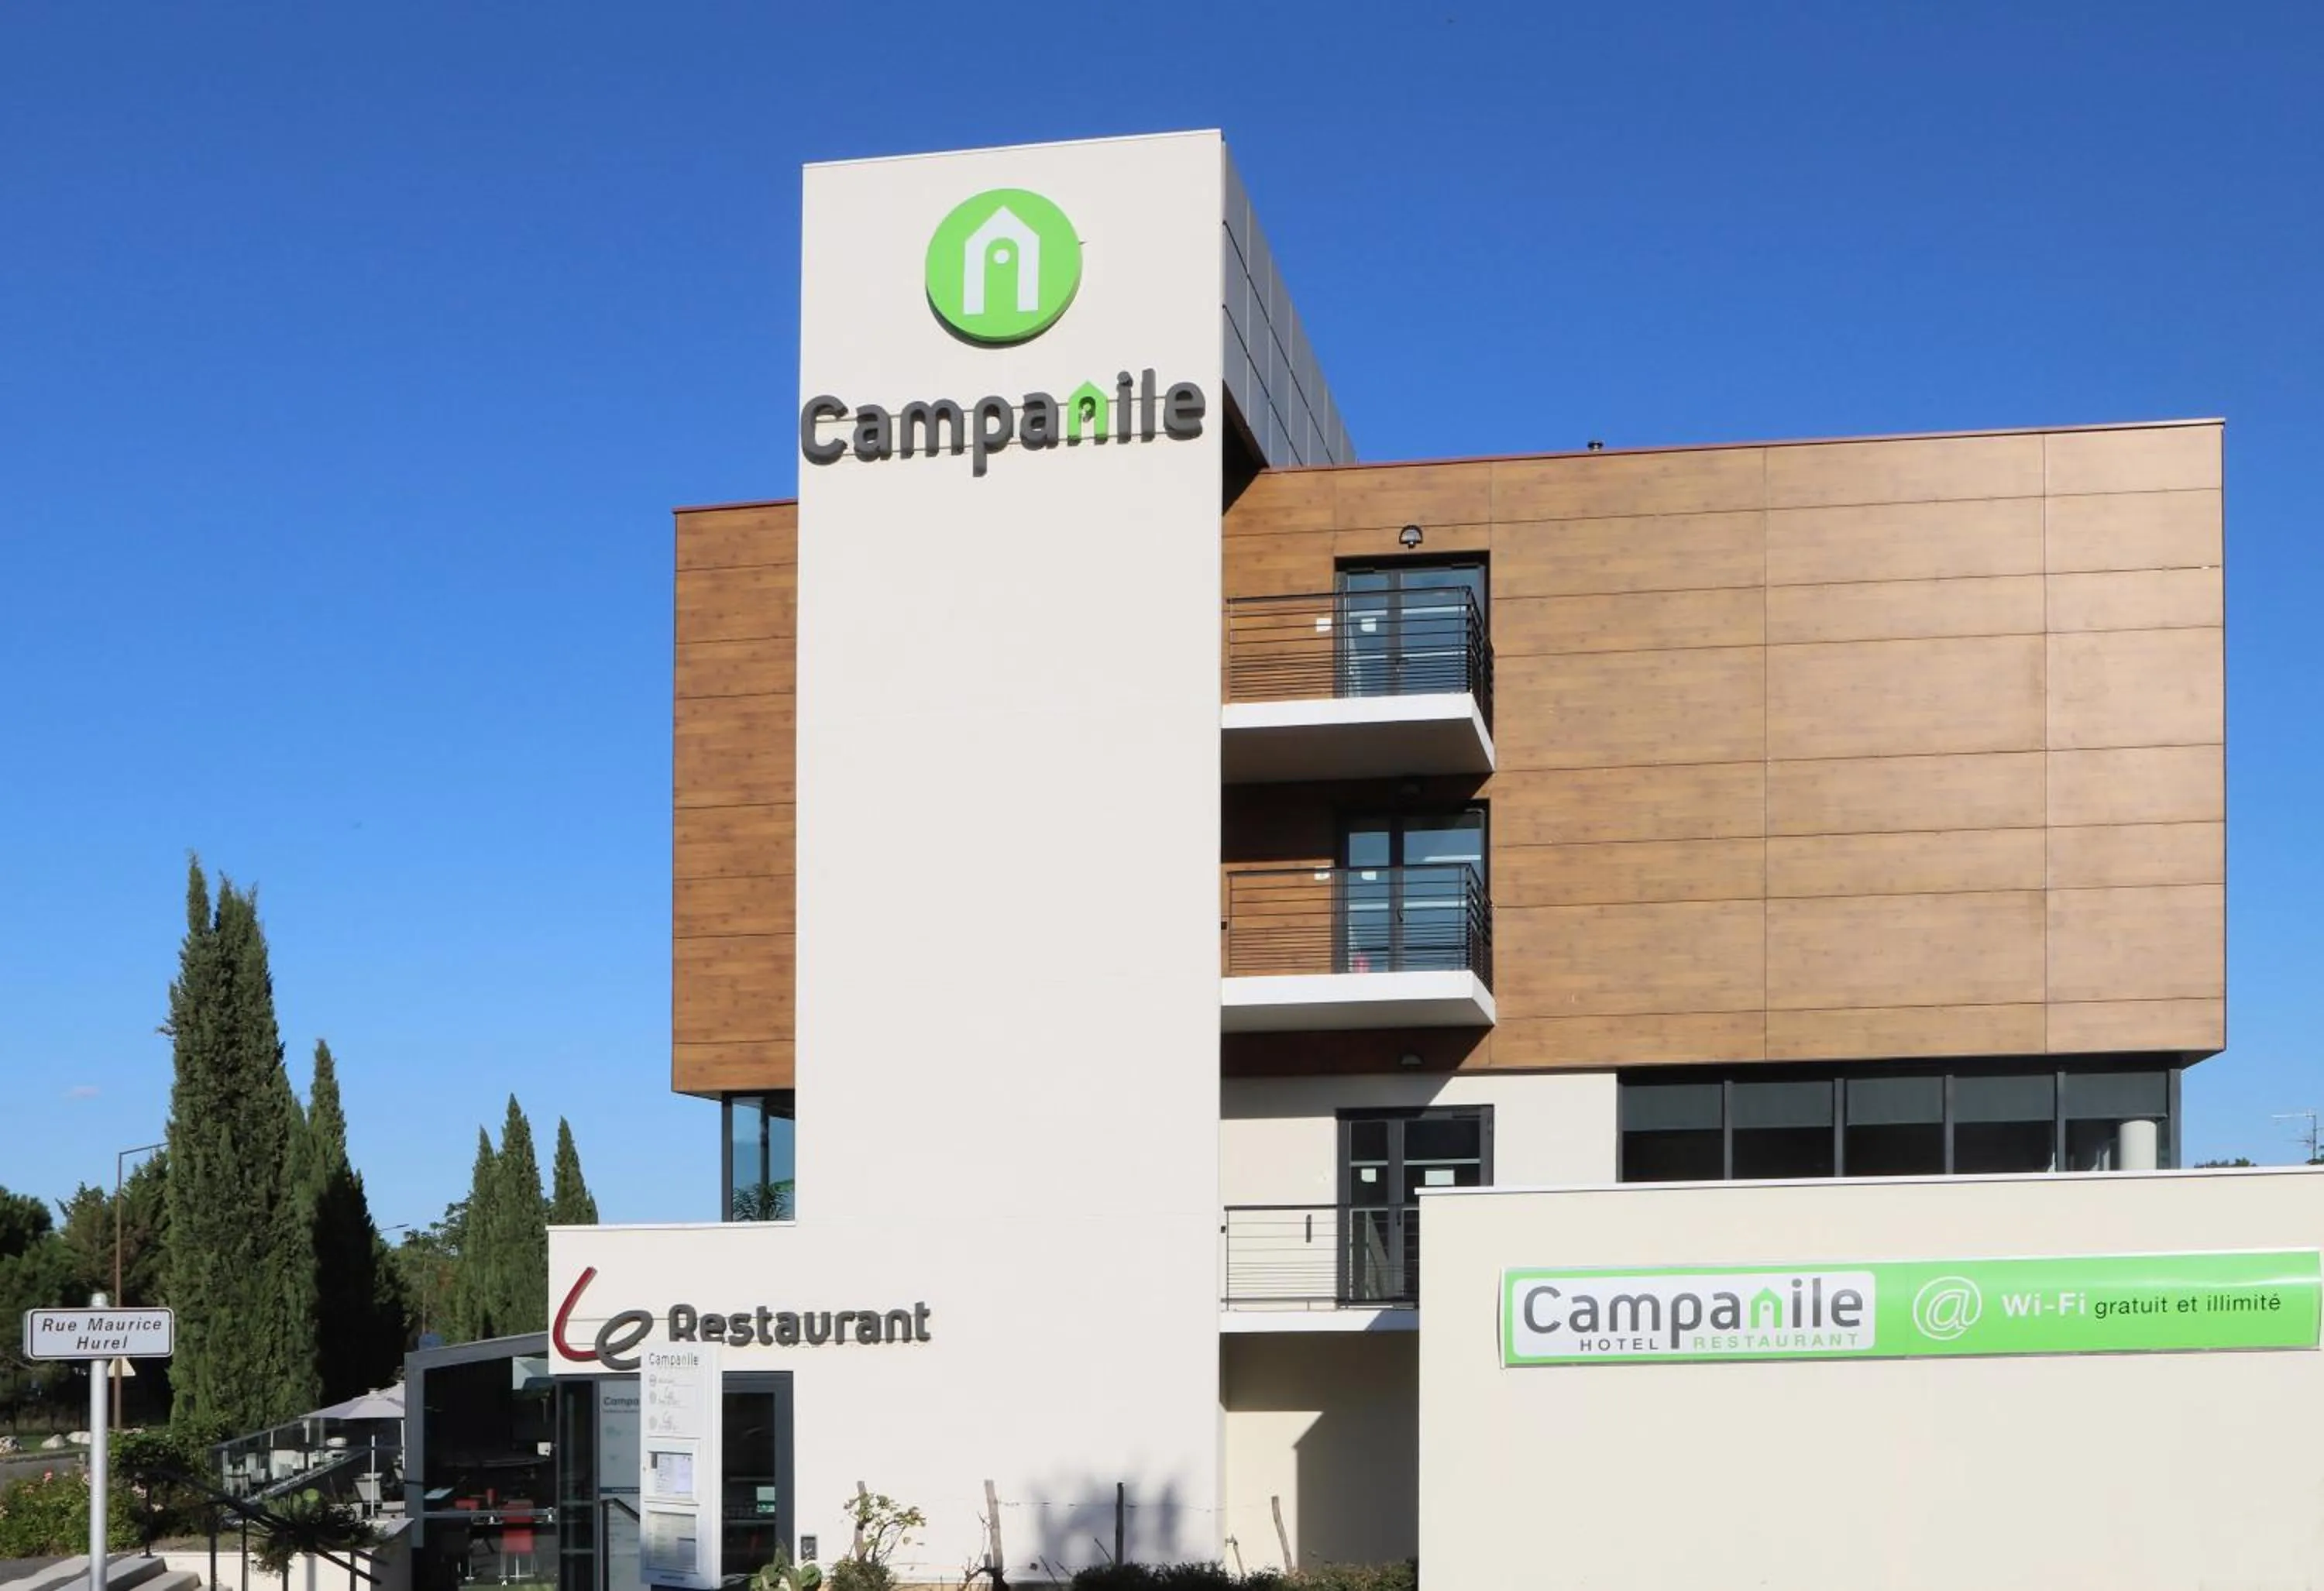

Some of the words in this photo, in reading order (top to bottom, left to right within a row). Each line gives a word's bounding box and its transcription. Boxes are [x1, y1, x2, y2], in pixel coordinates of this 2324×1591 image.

[800, 368, 1206, 477] Campanile
[552, 1266, 653, 1371] Le
[668, 1301, 931, 1347] Restaurant
[1524, 1277, 1864, 1349] Campanile
[2002, 1292, 2086, 1318] Wi-Fi
[2094, 1295, 2168, 1319] gratuit
[2177, 1299, 2198, 1312] et
[2206, 1293, 2281, 1312] illimité
[42, 1318, 77, 1332] Rue
[87, 1317, 162, 1332] Maurice
[77, 1335, 128, 1350] Hurel
[1580, 1337, 1659, 1352] HOTEL
[1693, 1333, 1859, 1349] RESTAURANT
